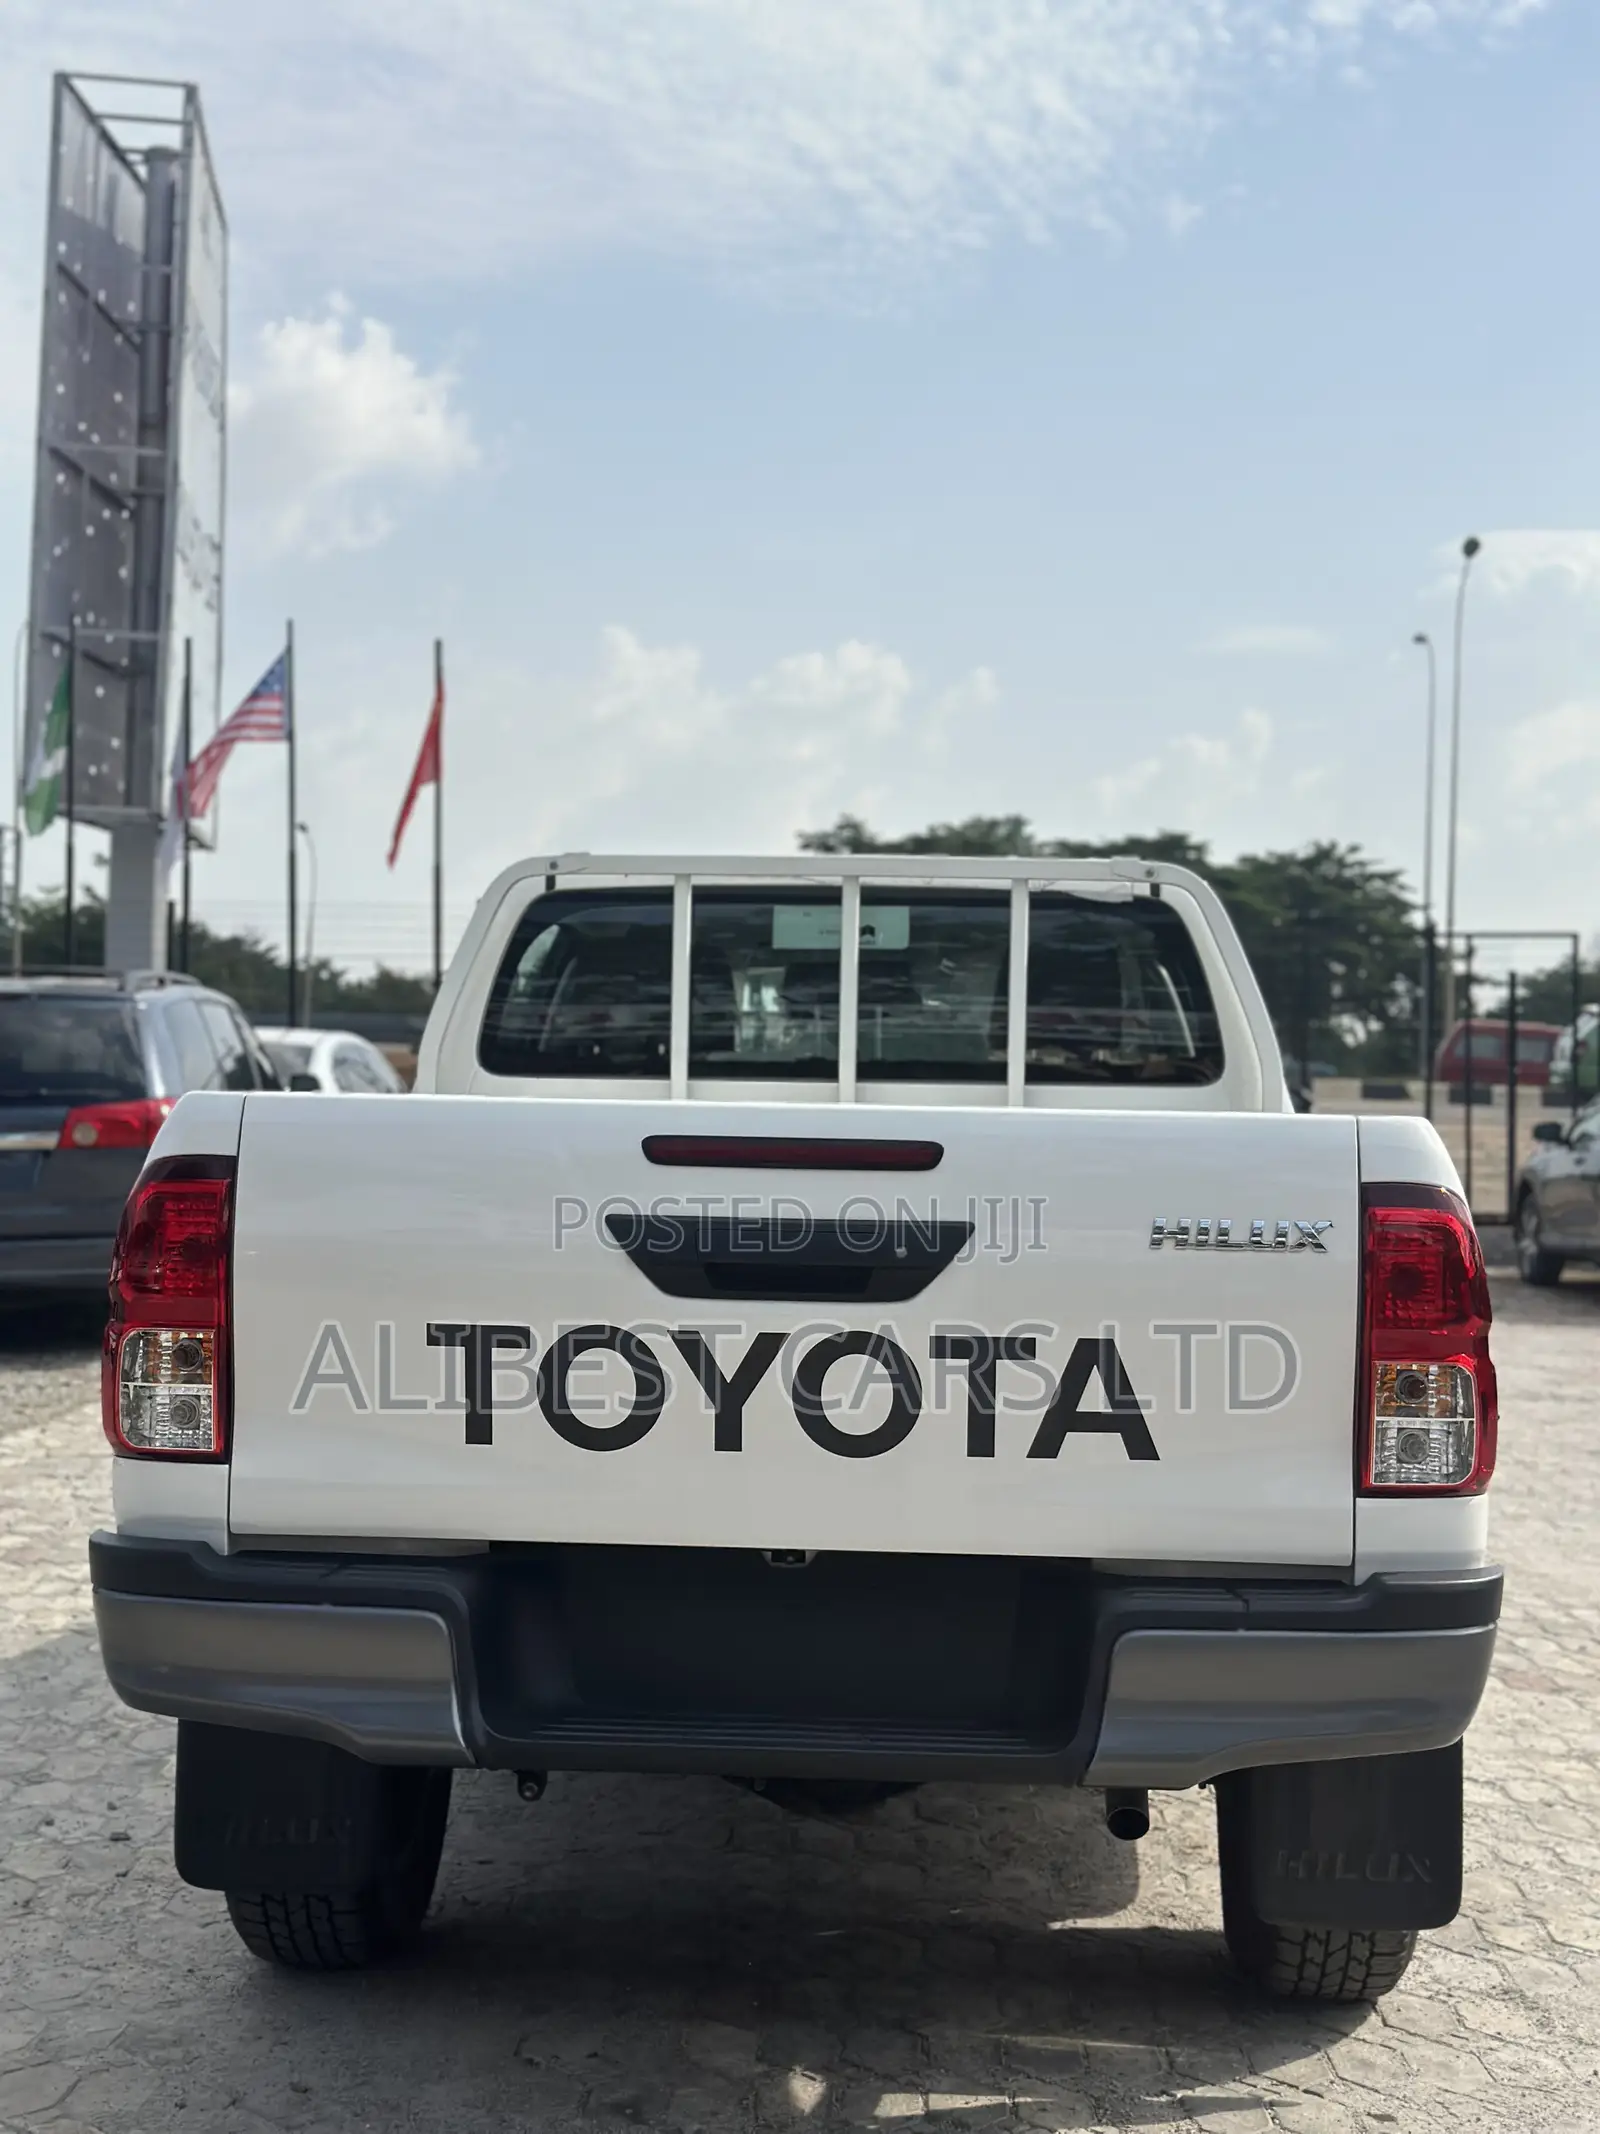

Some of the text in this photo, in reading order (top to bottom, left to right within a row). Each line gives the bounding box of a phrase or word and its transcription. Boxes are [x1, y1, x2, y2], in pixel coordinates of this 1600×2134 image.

[1150, 1217, 1334, 1253] HILUX
[426, 1321, 1161, 1461] TOYOTA
[1276, 1849, 1434, 1884] HILUX
